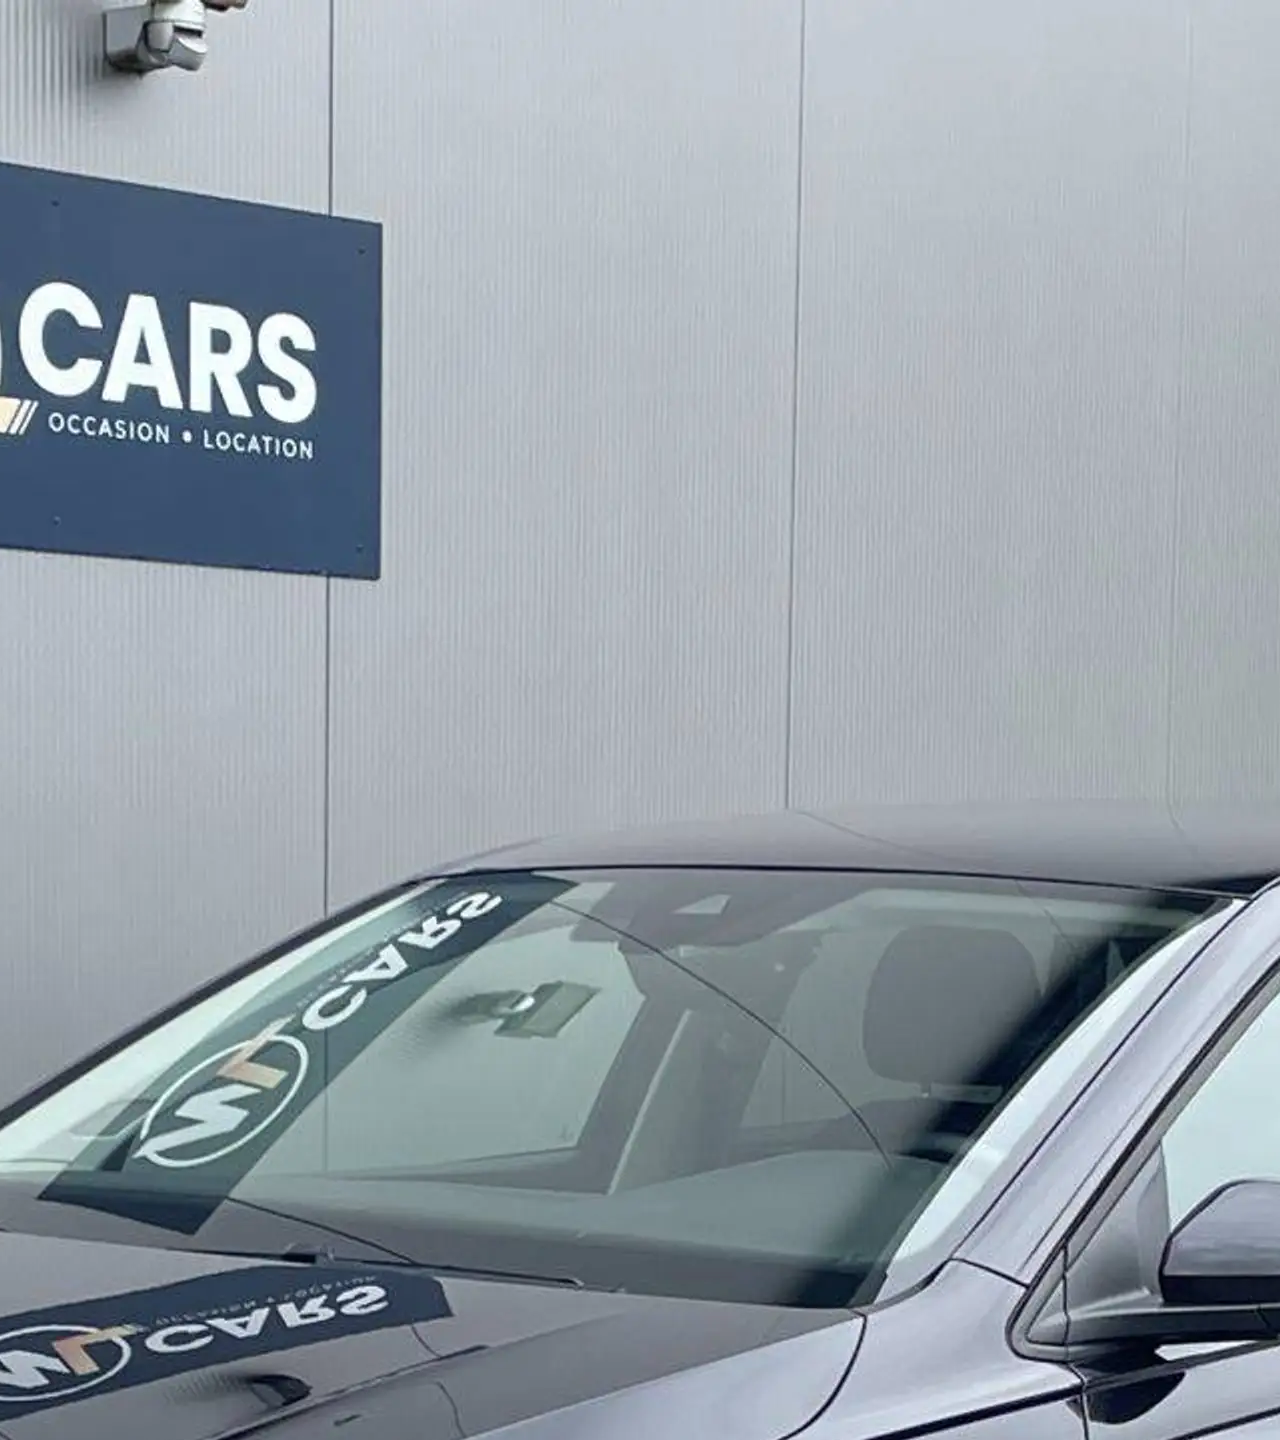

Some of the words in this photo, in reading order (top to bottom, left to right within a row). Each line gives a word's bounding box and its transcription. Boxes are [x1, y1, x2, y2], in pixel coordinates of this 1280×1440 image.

[19, 281, 317, 423] CARS
[48, 412, 169, 444] OCCASION
[204, 429, 314, 459] LOCATION
